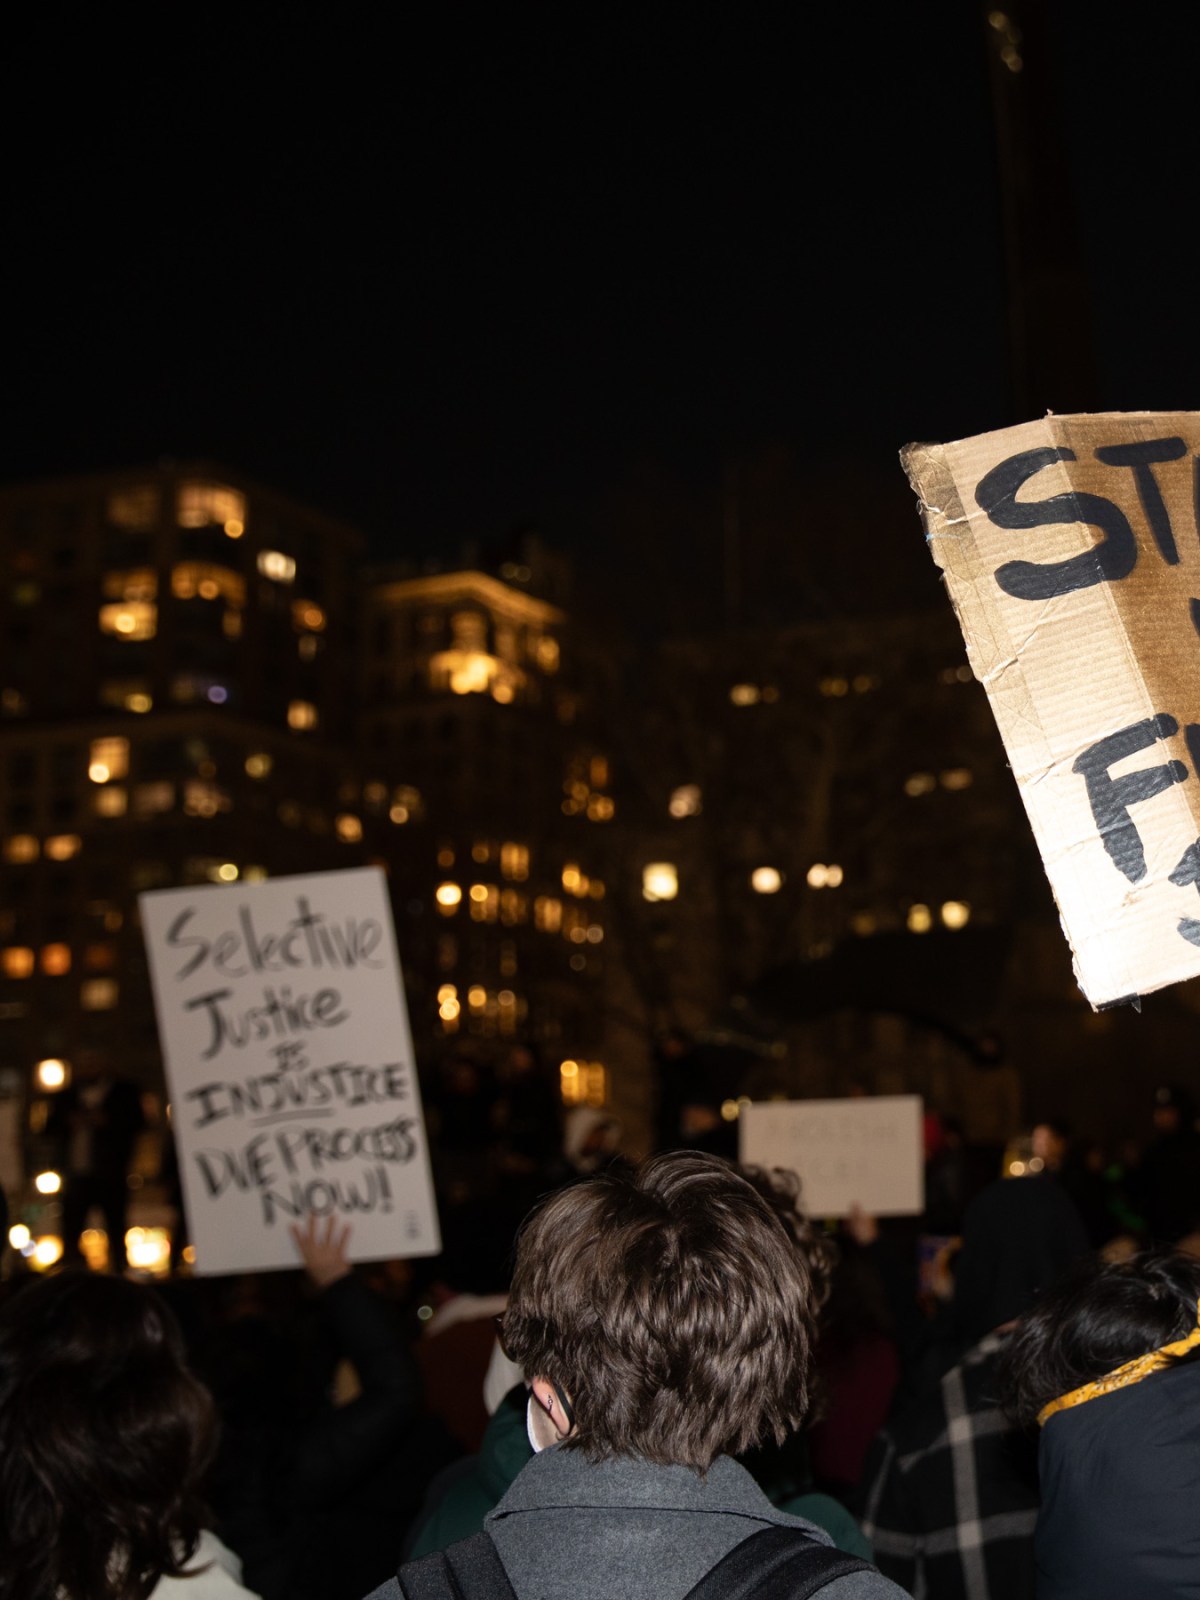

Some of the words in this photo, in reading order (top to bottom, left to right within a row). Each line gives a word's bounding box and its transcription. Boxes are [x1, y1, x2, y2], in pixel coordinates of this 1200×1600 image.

[166, 895, 387, 981] Selective
[183, 985, 350, 1060] Justice
[185, 1060, 411, 1129] INJUSTICE
[194, 1130, 279, 1200] DUE
[275, 1117, 420, 1174] PROCESS
[262, 1165, 396, 1228] NOW!
